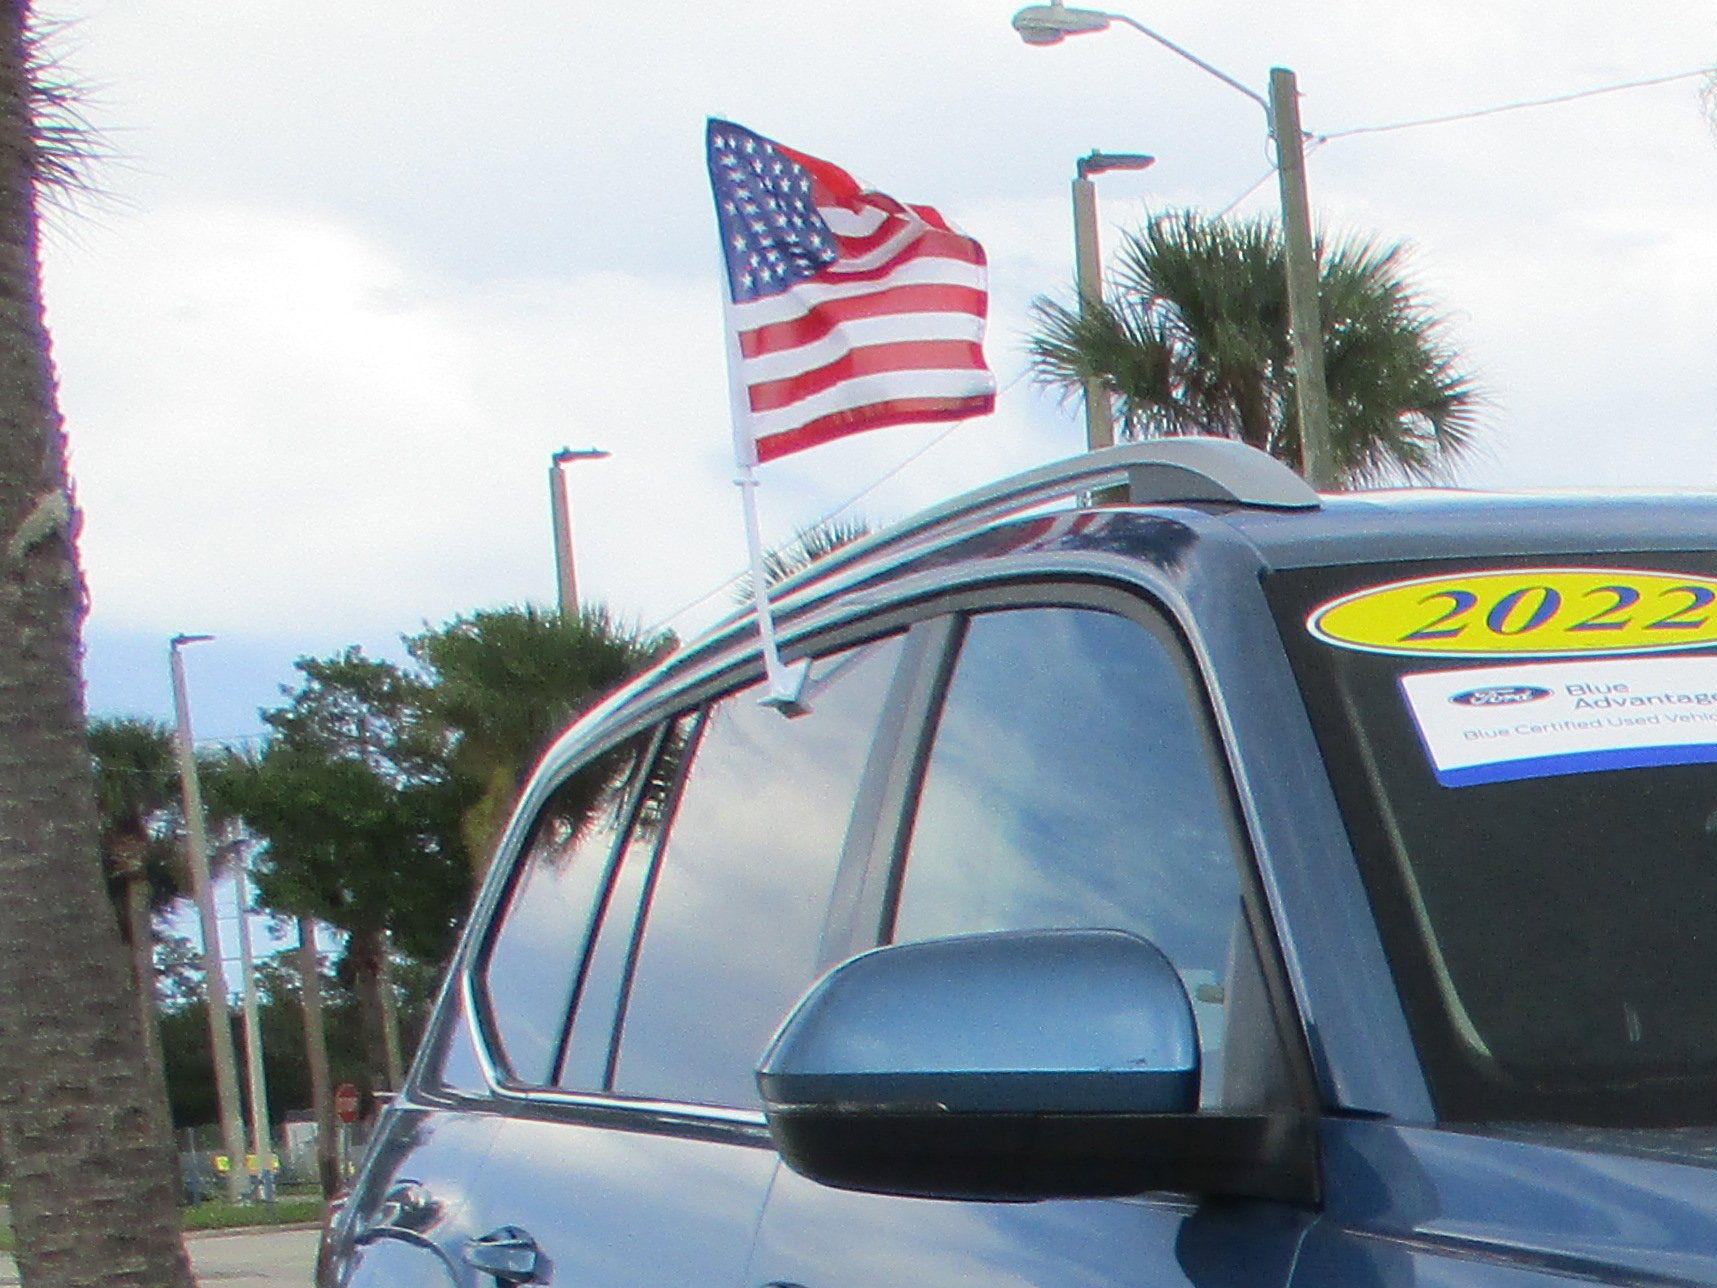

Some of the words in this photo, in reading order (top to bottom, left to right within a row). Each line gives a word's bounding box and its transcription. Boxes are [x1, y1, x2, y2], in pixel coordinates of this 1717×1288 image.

[1397, 585, 1716, 642] 2022
[1565, 682, 1629, 696] Blue
[1463, 728, 1509, 741] Blue
[1514, 718, 1602, 736] Certified
[1607, 714, 1660, 727] Used
